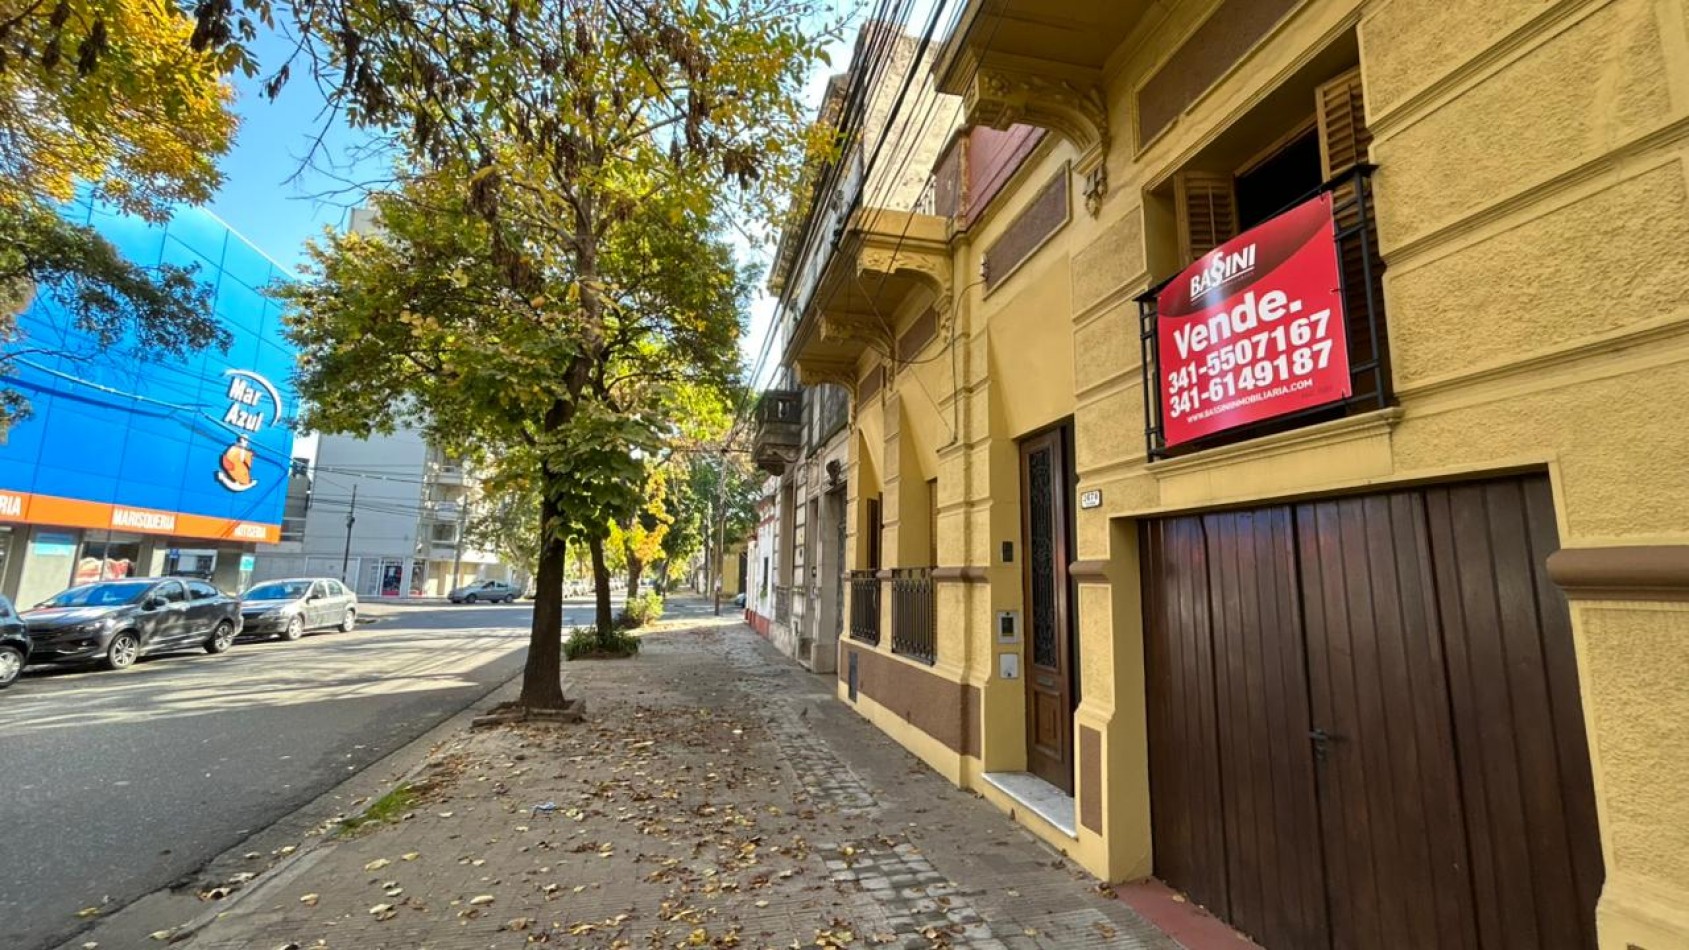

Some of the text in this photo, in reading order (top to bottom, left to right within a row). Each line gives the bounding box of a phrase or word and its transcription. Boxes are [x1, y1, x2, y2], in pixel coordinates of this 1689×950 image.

[1168, 309, 1331, 394] 341-5507167
[1173, 290, 1302, 359] Vende.
[228, 377, 262, 406] Mar
[1170, 339, 1333, 418] 341-6149187
[224, 402, 264, 432] Azul
